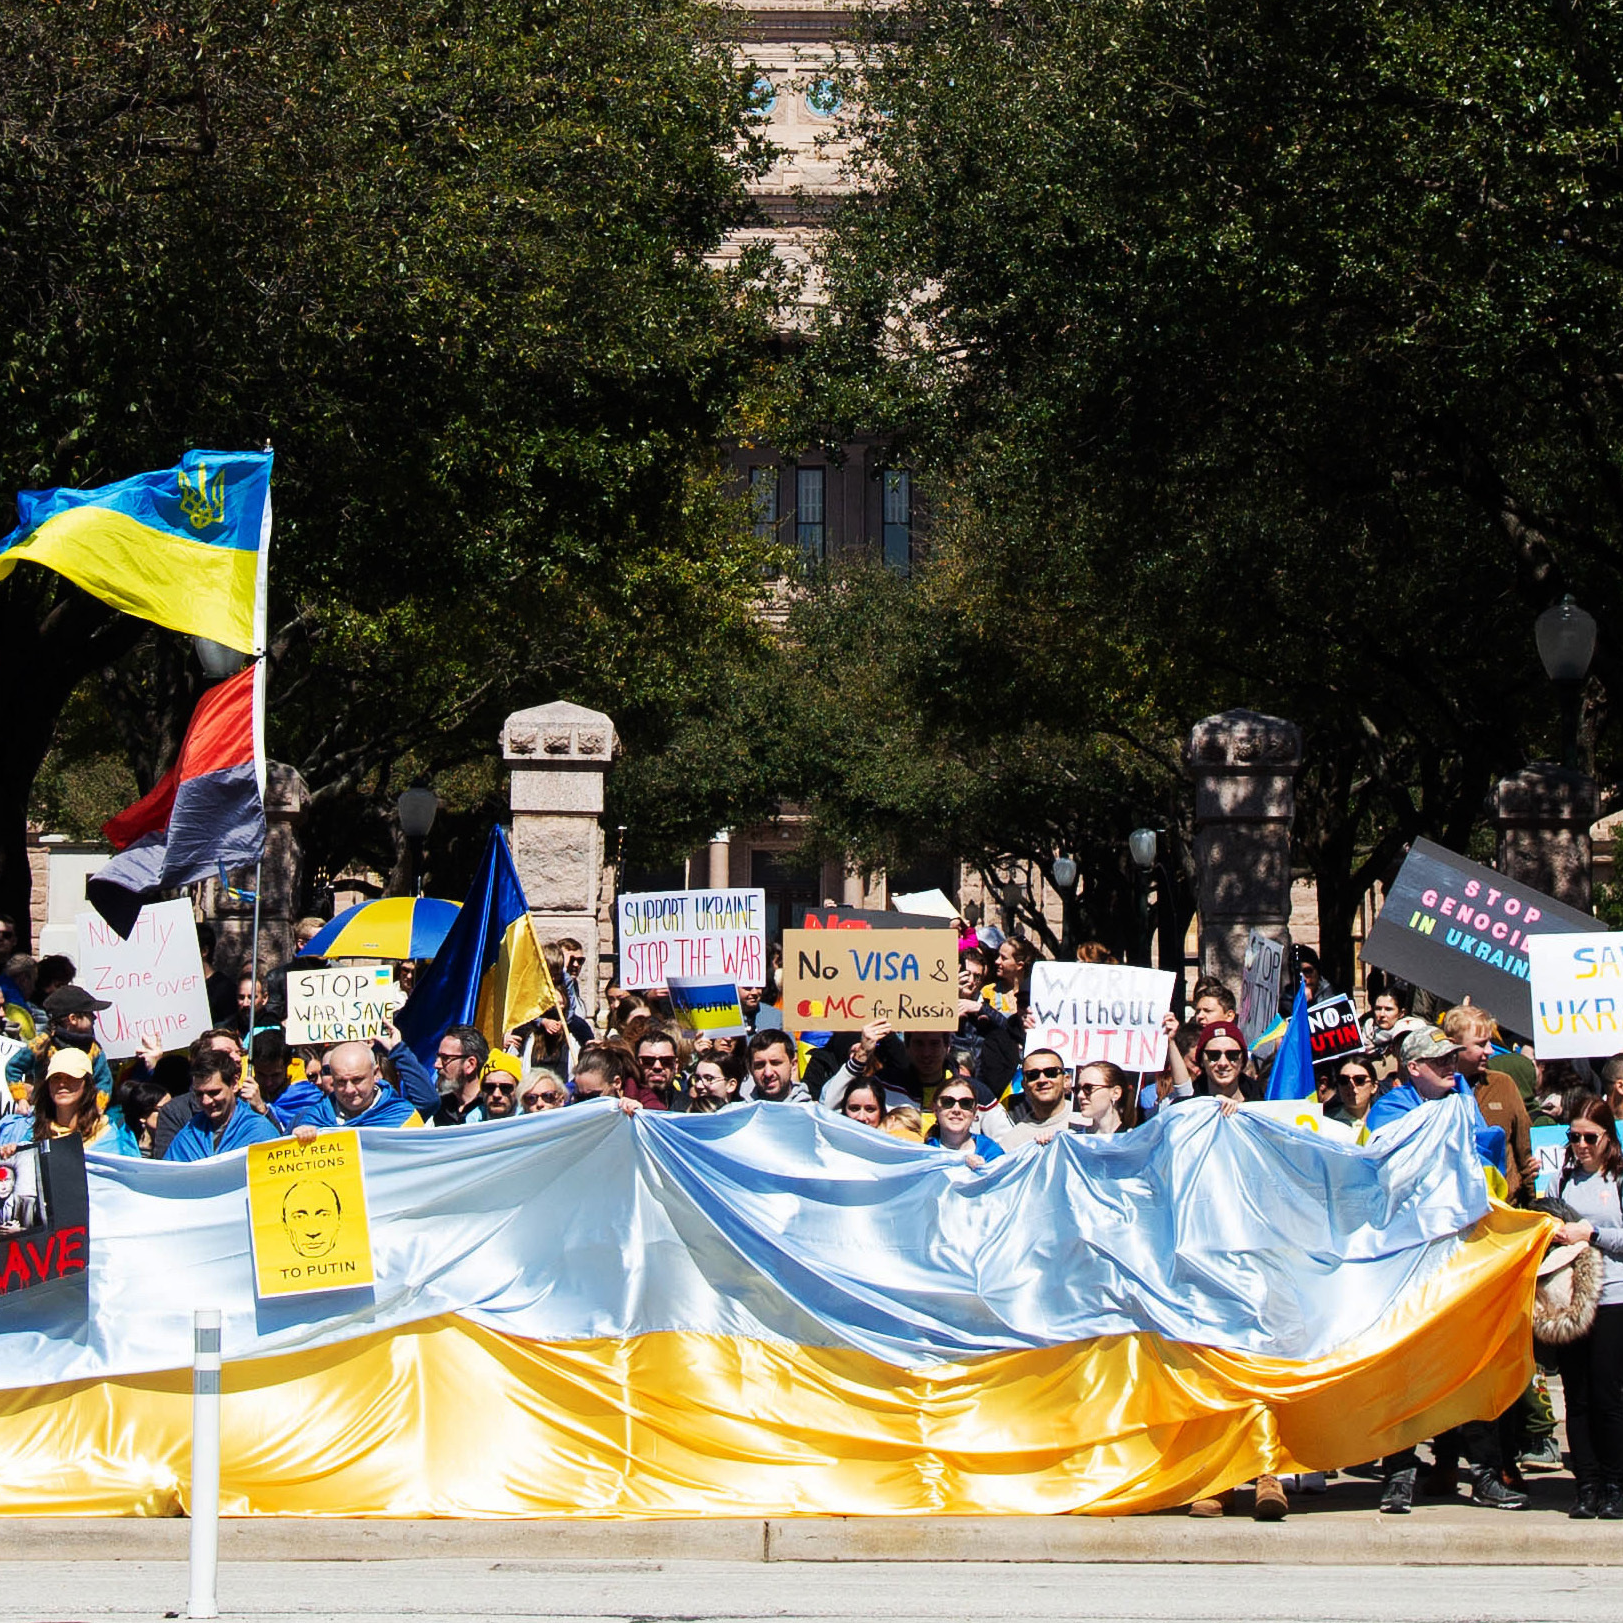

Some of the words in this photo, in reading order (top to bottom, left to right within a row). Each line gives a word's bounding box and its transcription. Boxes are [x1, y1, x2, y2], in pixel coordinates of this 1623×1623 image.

[624, 897, 688, 937] SUPPORT
[695, 894, 759, 931] UKRAINE
[1464, 880, 1542, 924] STOP
[1421, 889, 1530, 954] GENOCI
[627, 940, 669, 986] STOP
[720, 934, 761, 982] WAR
[1409, 910, 1437, 936] IN
[1445, 927, 1531, 982] UKRAIN
[848, 949, 919, 982] VISA
[929, 958, 949, 982] &
[93, 966, 155, 991] Zone
[156, 975, 199, 997] over
[300, 973, 369, 997] STOP
[294, 1000, 345, 1022] WAR!
[350, 1001, 393, 1021] SAVE
[697, 1000, 732, 1014] PUTIN
[823, 994, 866, 1019] MC
[871, 999, 893, 1018] for
[898, 993, 954, 1020] Russia
[1308, 1007, 1340, 1034] NO
[1341, 1012, 1354, 1024] TO
[95, 1005, 192, 1044] Ukraine
[1310, 1023, 1359, 1053] UTIN
[1047, 1028, 1160, 1066] PUTIN
[267, 1146, 306, 1161] APPLY
[310, 1142, 345, 1155] REAL
[268, 1156, 345, 1175] SANCTIONS
[280, 1267, 302, 1279] TO
[307, 1260, 356, 1276] PUTIN
